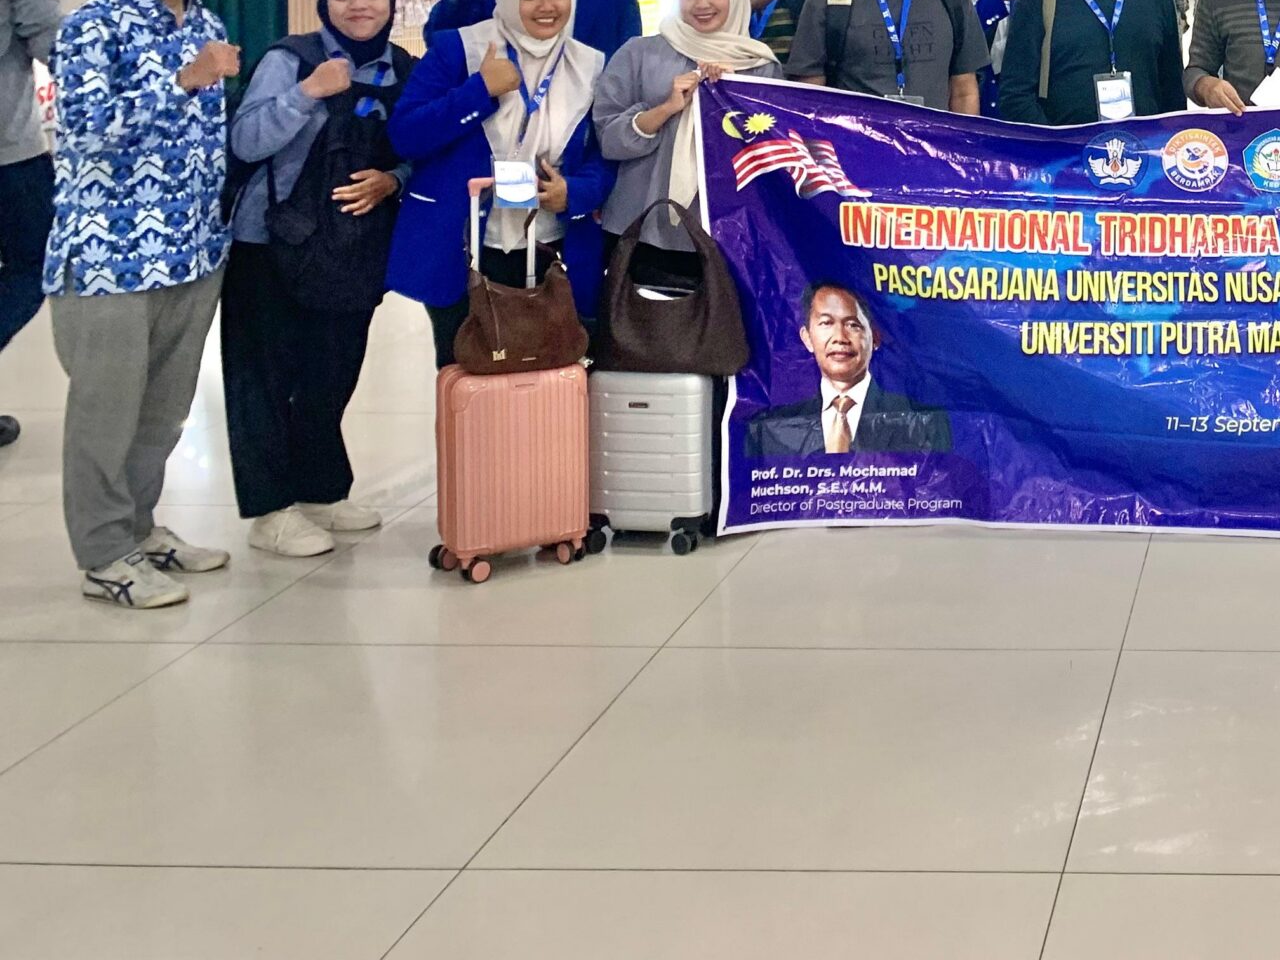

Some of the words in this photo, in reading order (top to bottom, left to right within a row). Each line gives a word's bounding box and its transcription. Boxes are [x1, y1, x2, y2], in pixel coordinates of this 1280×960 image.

[1168, 132, 1222, 153] DIKTISAINTEK
[1170, 169, 1220, 187] BERDAMPAK
[840, 203, 1091, 254] INTERNATIONAL
[873, 263, 1060, 302] PASCASARJANA
[1066, 270, 1219, 304] UNIVERSITAS
[1021, 321, 1154, 355] UNIVERSITI
[1161, 321, 1241, 355] PUTRA
[751, 469, 779, 481] Prof.
[783, 467, 803, 478] Dr.
[807, 467, 836, 478] Drs.
[840, 464, 917, 477] Mochamad
[751, 483, 813, 498] Muchson,
[852, 482, 886, 494] M.M.
[750, 500, 796, 515] Director
[800, 498, 814, 510] of
[817, 498, 904, 513] Postgraduate
[908, 498, 963, 512] Program
